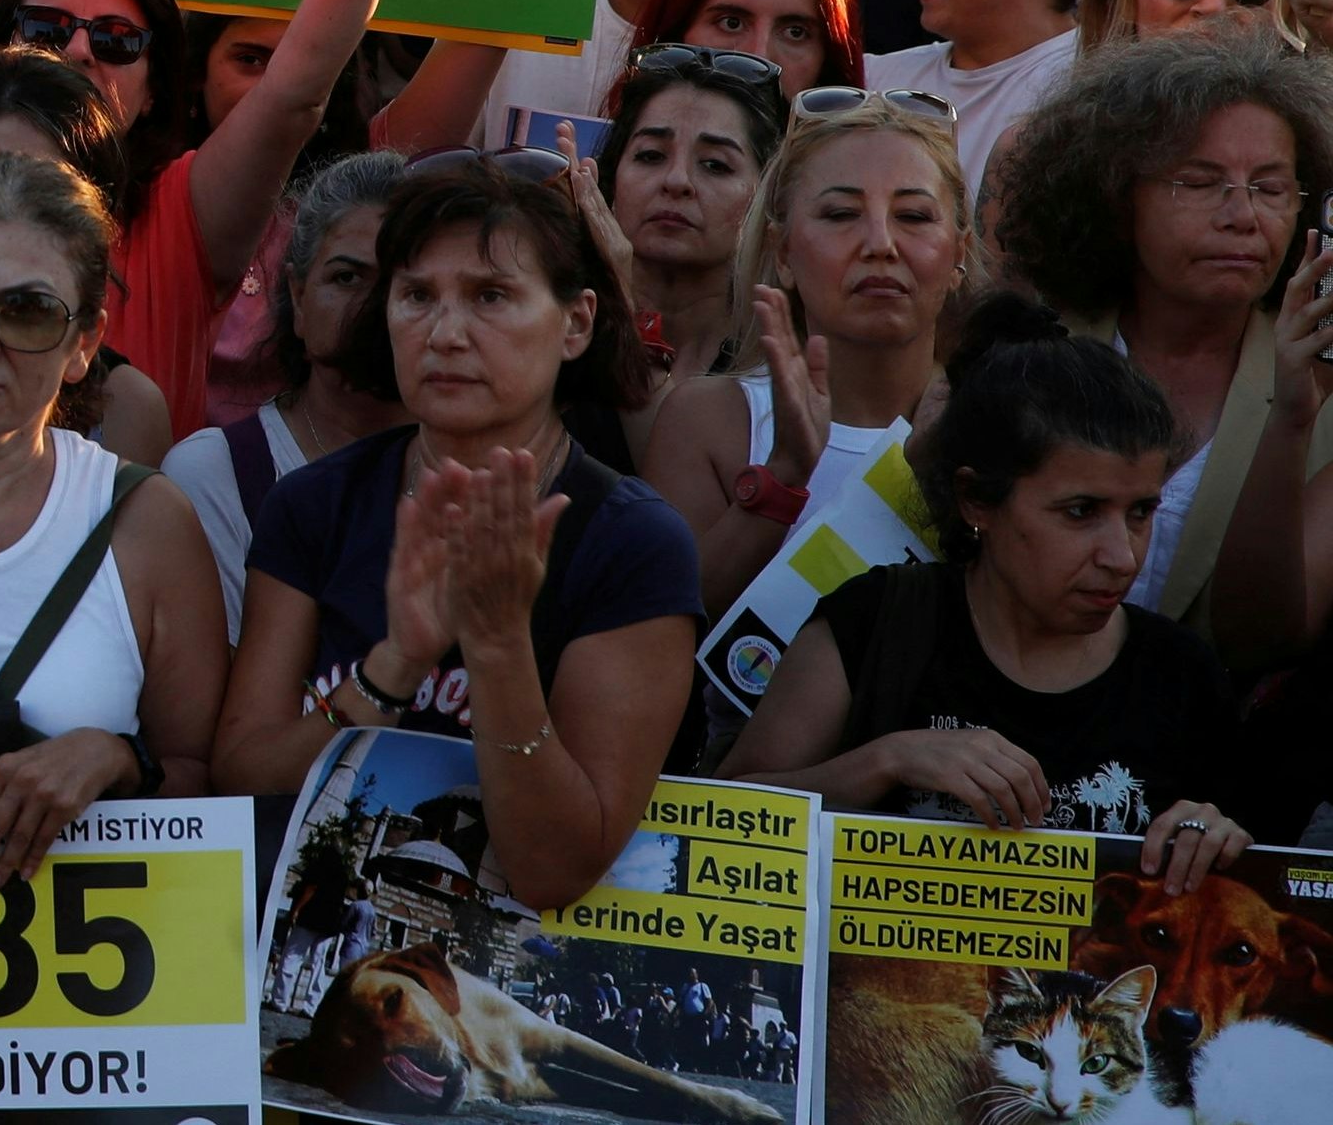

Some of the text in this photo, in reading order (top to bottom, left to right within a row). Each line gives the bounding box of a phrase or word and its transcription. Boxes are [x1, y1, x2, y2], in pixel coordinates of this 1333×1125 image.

[96, 811, 204, 842] İSTİYOR
[840, 827, 1090, 872] TOPLAYAMAZSIN
[695, 854, 799, 896] Aşılat
[841, 874, 1087, 918] HAPSEDEMEZSİN
[552, 901, 799, 957] Yerinde Yaşat
[838, 914, 1063, 963] ÖLDÜREMEZSİN
